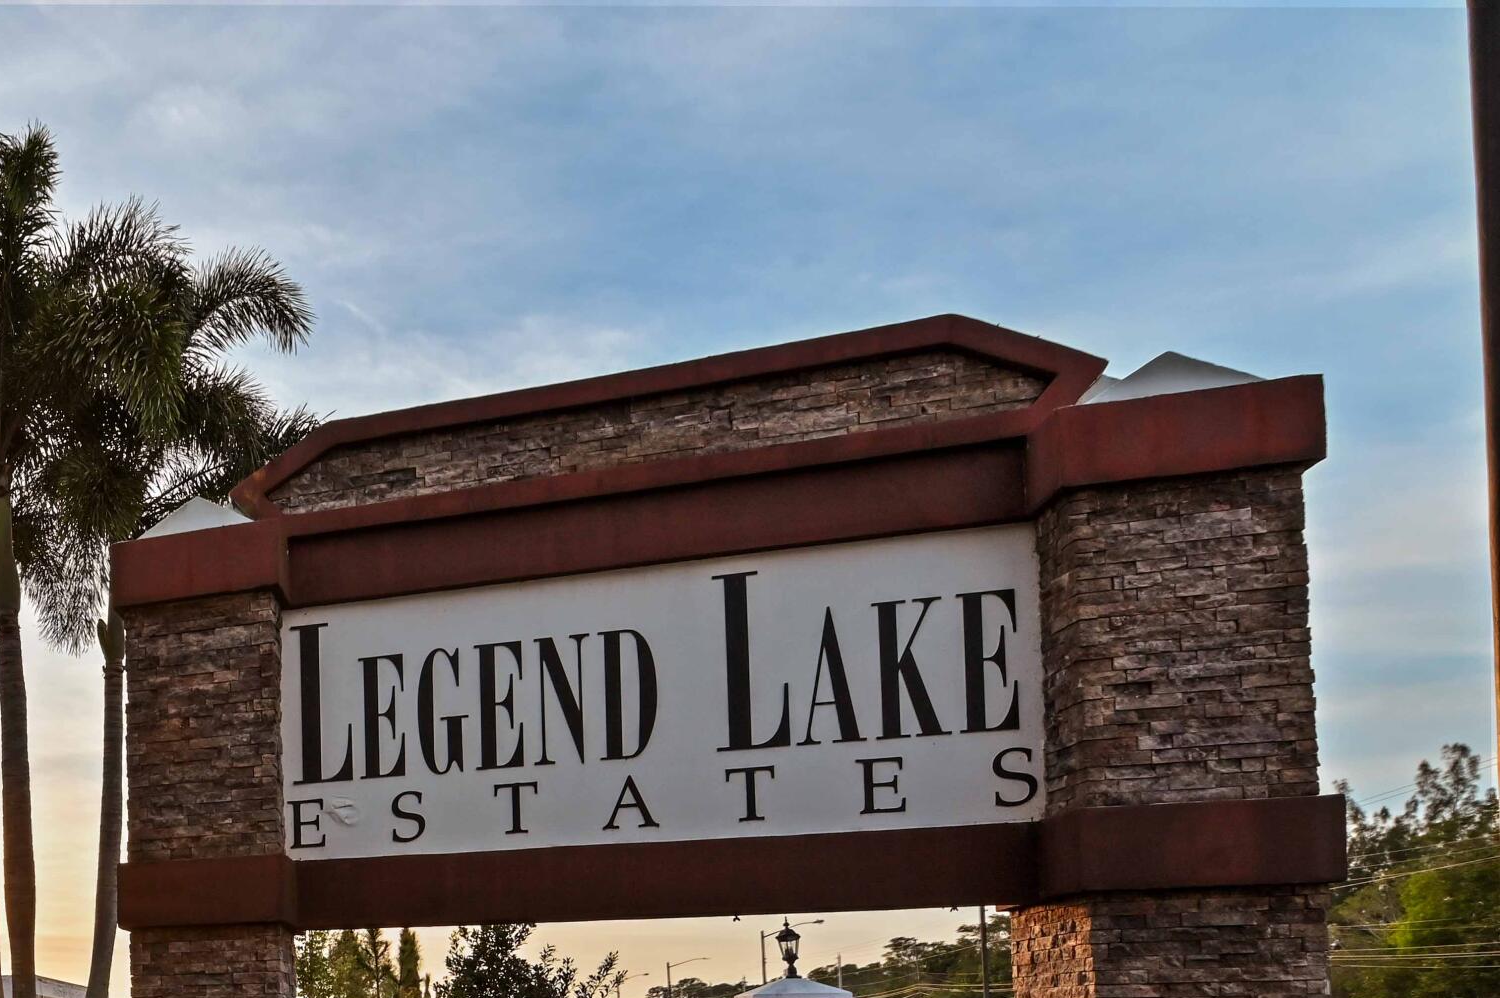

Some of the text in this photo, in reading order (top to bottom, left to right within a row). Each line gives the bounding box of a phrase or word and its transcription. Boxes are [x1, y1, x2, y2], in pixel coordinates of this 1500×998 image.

[289, 571, 1020, 786] LEGEND LAKE
[287, 747, 1041, 849] ESTATES
